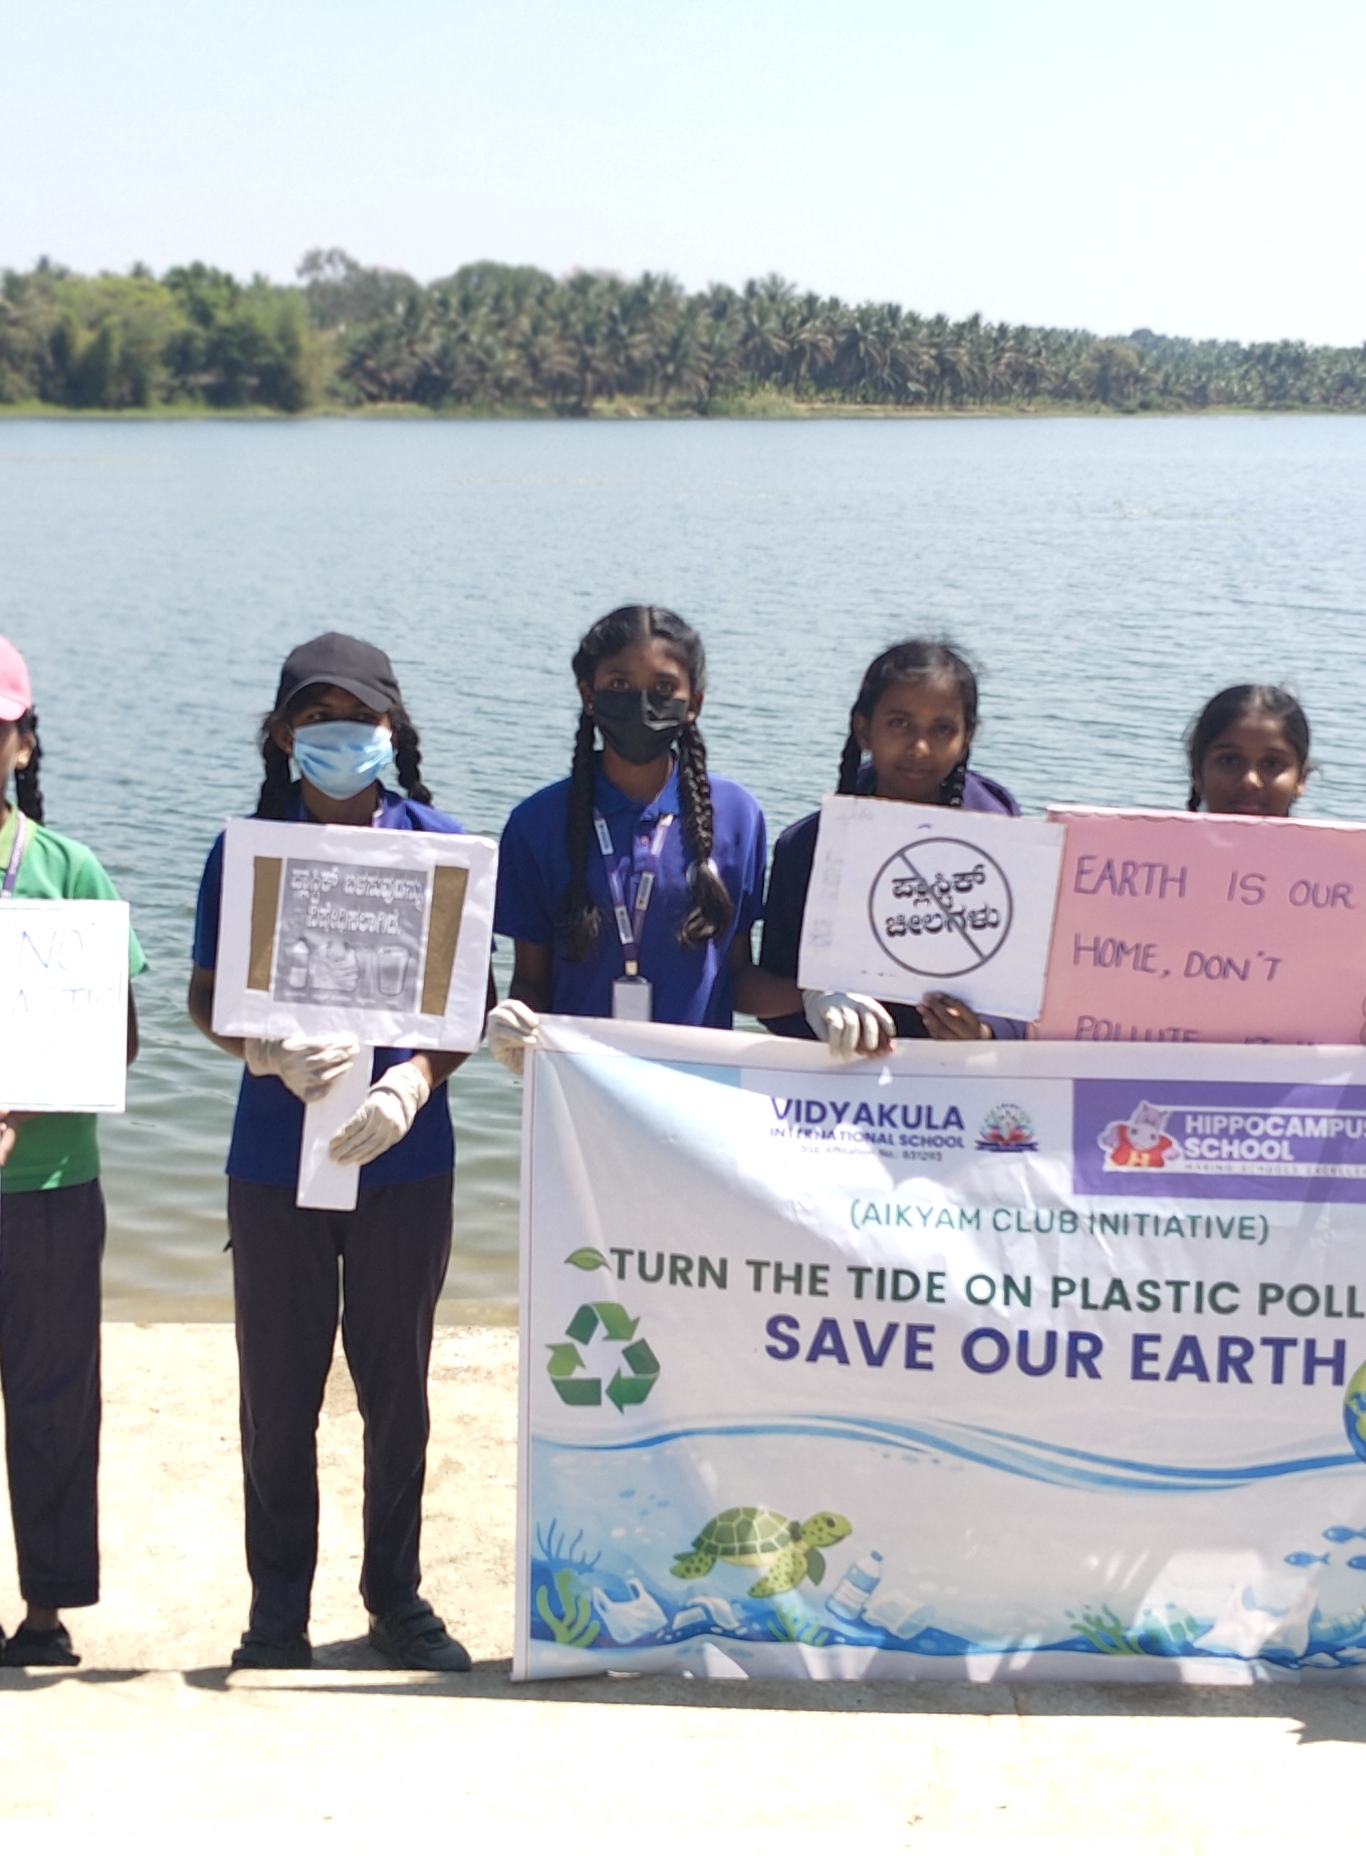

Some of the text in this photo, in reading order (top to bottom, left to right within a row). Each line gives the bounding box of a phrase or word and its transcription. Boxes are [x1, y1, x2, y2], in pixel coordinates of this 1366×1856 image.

[1073, 854, 1357, 910] EARTH IS OUR
[1072, 932, 1283, 982] HOME, DON'T
[770, 1095, 966, 1131] VIDYAKULA
[898, 1133, 966, 1149] SCHOOL
[1184, 1137, 1295, 1162] SCHOOL
[849, 1200, 1270, 1246] (AIKYAM CLUB INITIATIVE)
[609, 1246, 729, 1290] TURN
[745, 1258, 830, 1298] THE
[846, 1265, 946, 1304] TIDE
[965, 1273, 1033, 1308] ON
[1050, 1275, 1241, 1316] PLASTIC
[764, 1312, 1348, 1387] SAVE OUR EARTH
